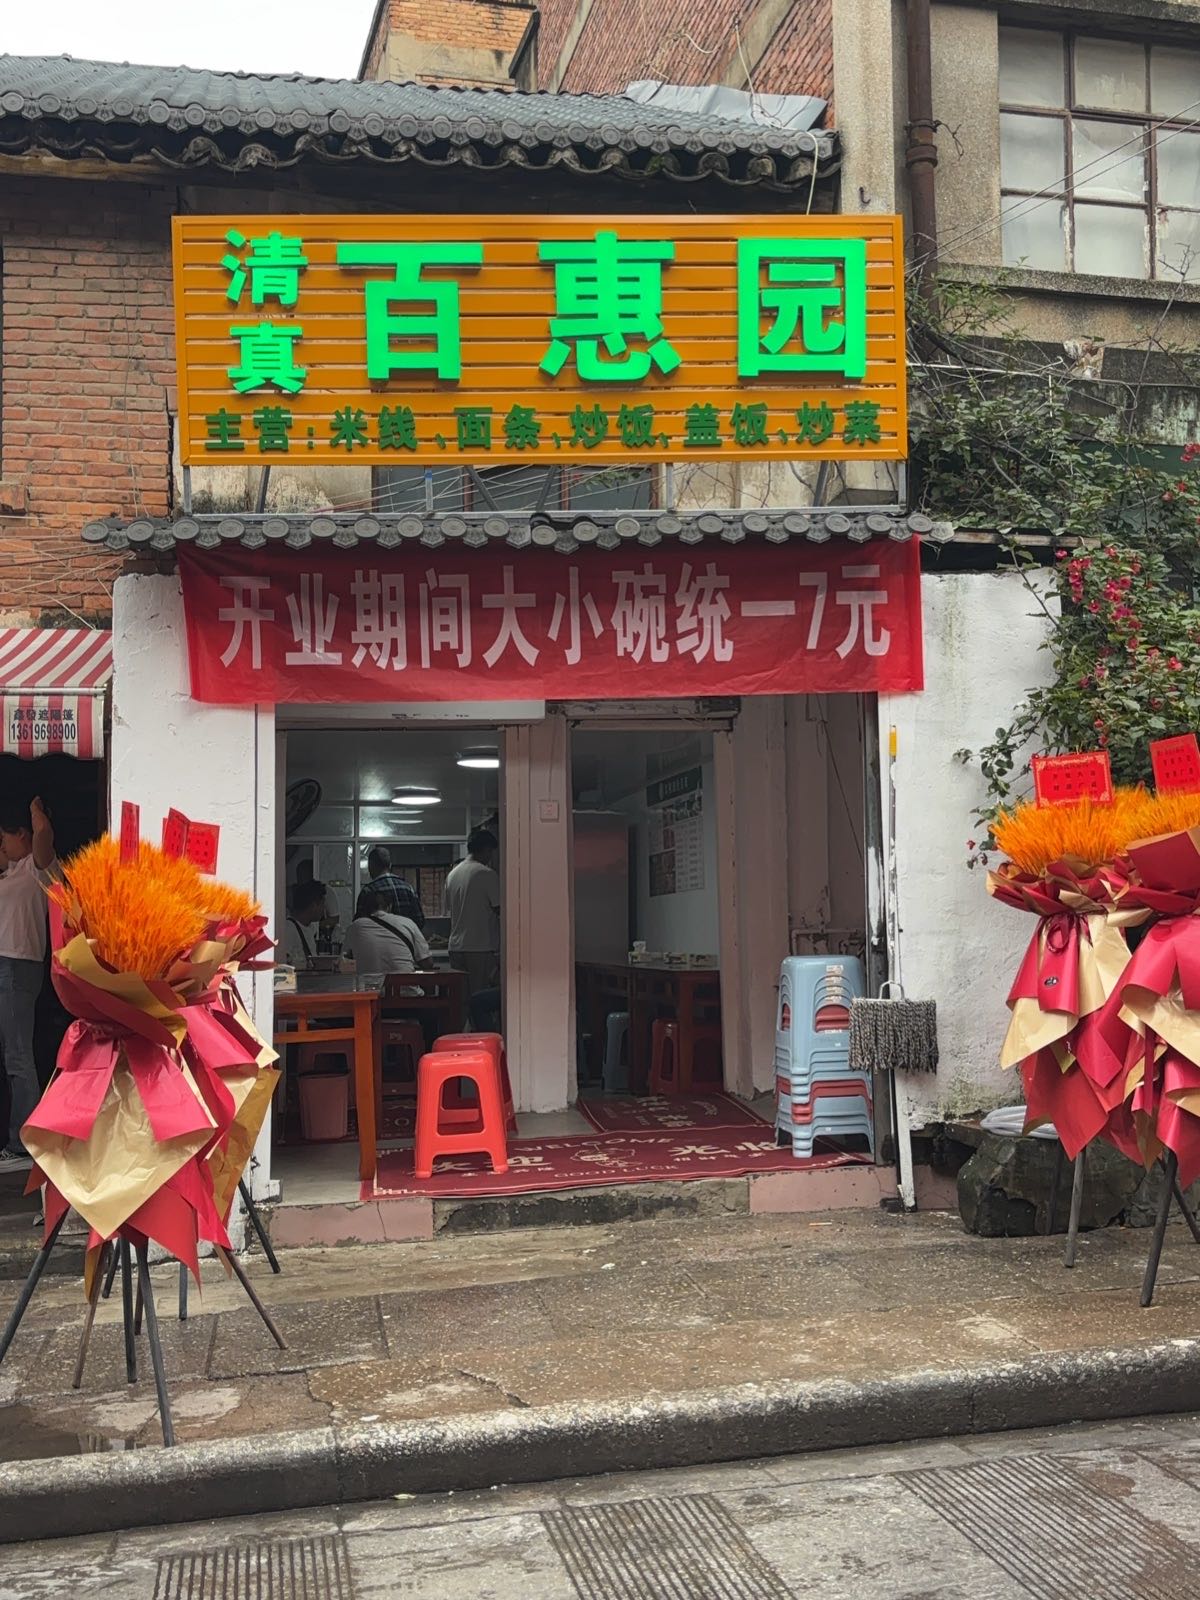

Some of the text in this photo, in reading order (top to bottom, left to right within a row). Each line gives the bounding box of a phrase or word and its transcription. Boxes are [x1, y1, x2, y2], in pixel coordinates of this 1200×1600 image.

[221, 230, 308, 394] 清真
[336, 231, 868, 381] 百惠园
[218, 562, 891, 671] 开业期间大小碗统一7元
[11, 723, 76, 740] 13619698900
[513, 1138, 675, 1151] WELCOME
[554, 1168, 616, 1178] GOOD
[623, 1164, 680, 1174] LUCK
